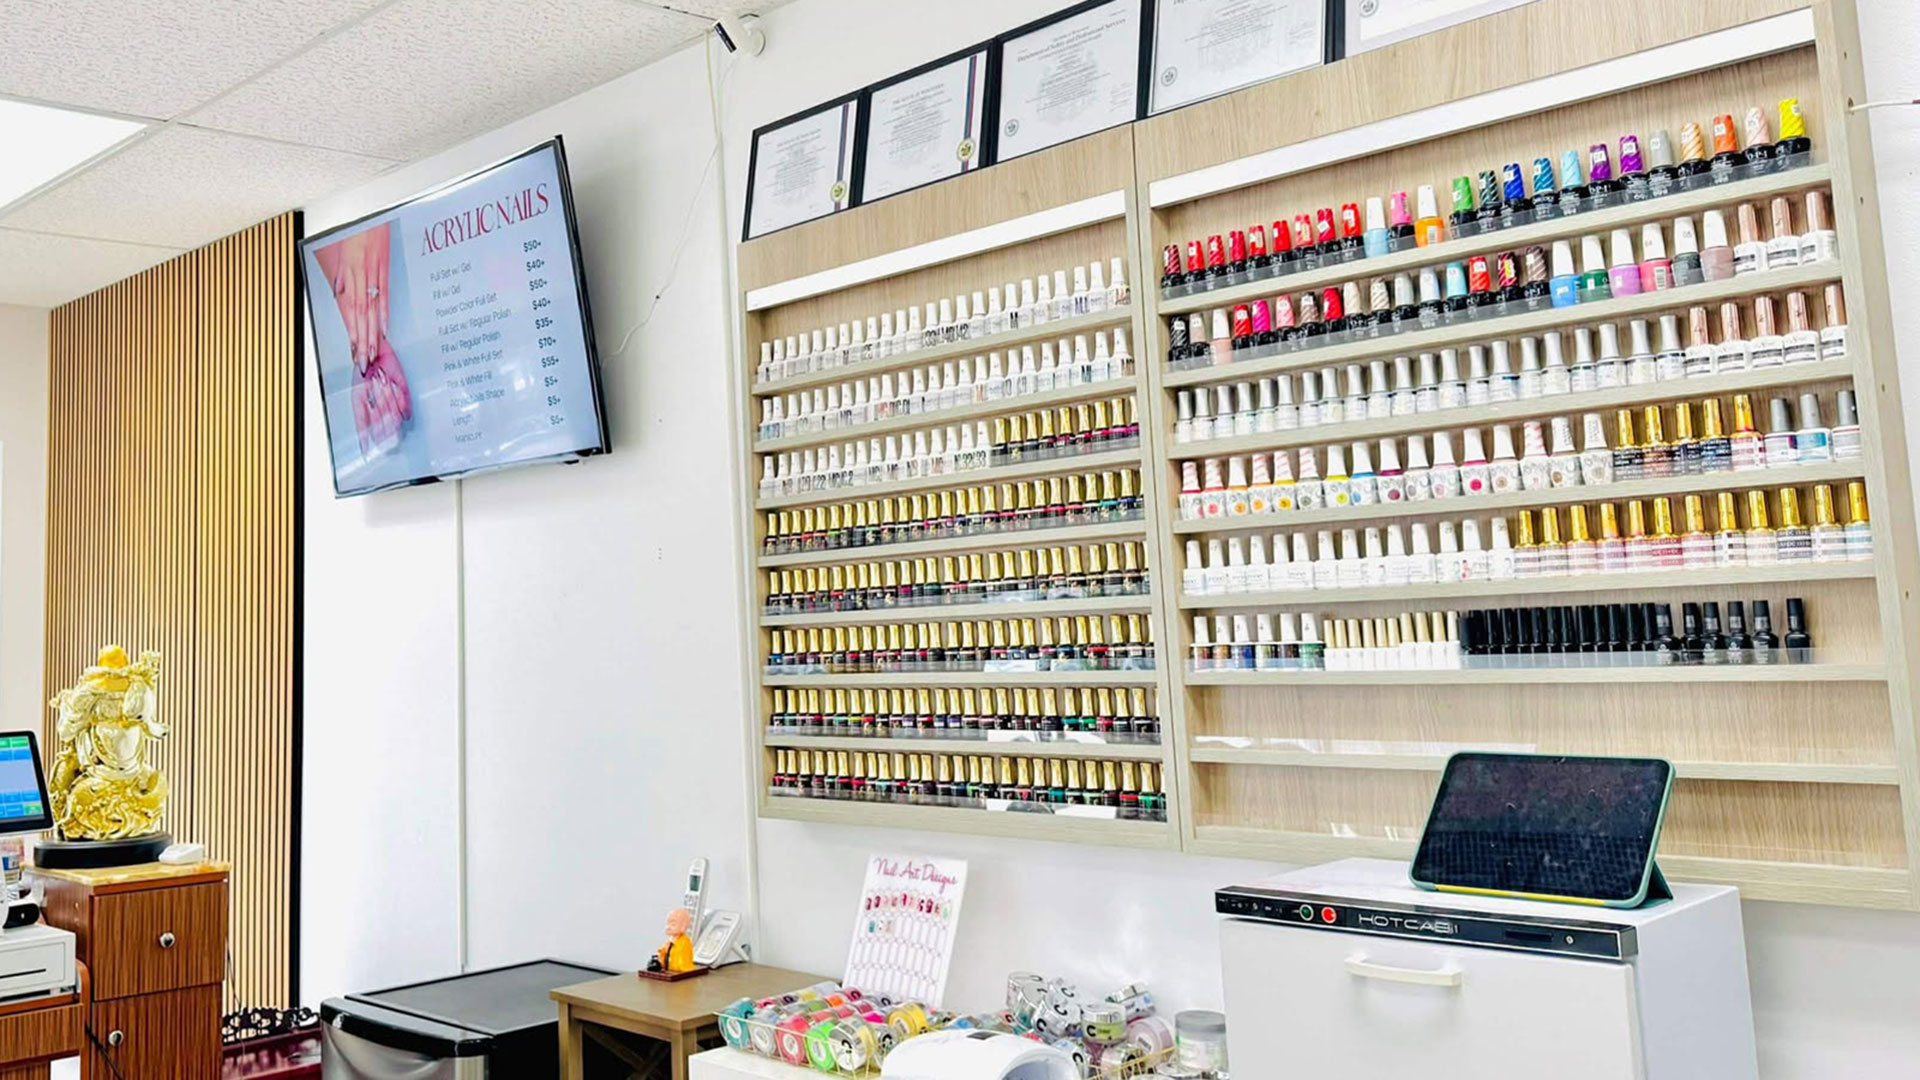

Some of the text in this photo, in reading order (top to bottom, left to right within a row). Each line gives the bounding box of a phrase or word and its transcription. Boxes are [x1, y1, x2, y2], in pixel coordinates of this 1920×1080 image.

[421, 182, 549, 256] ACRYLIC NAILS
[523, 239, 542, 253] $50+
[461, 261, 472, 273] Gel
[526, 258, 545, 272] $40+
[450, 284, 461, 295] Gel
[532, 297, 551, 311] $40+
[469, 314, 491, 328] Regular
[492, 308, 512, 320] Polish
[535, 316, 553, 330] $35+
[459, 337, 482, 350] Regular
[482, 331, 501, 343] Polish
[538, 336, 557, 349] $70+
[463, 356, 480, 367] White
[541, 355, 559, 369] $55+
[465, 374, 483, 385] White
[544, 375, 558, 388] $5+
[547, 395, 561, 407] $5+
[550, 414, 564, 426] $5+
[873, 857, 958, 894] Nail Art Designs
